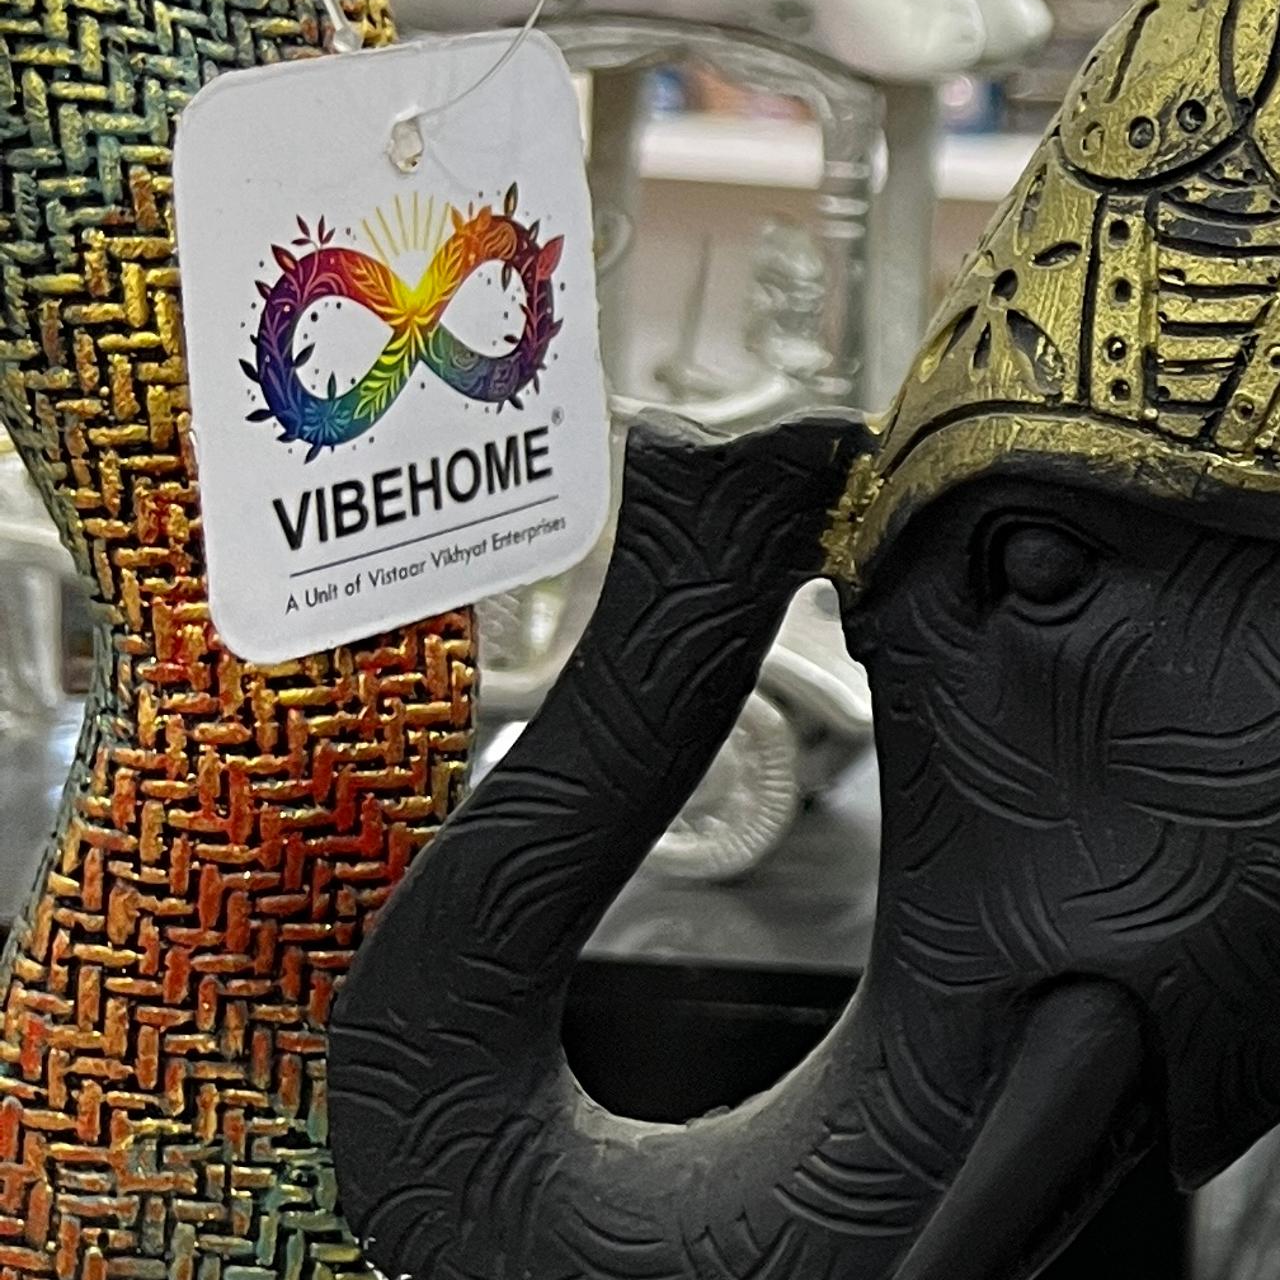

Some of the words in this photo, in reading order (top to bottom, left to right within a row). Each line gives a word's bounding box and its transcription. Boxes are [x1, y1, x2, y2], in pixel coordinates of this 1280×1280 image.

[271, 424, 554, 552] VIBEHOME
[284, 593, 299, 615] A
[305, 583, 338, 608] Unit
[344, 576, 362, 597] of
[367, 559, 426, 588] Vistaar
[430, 538, 488, 569] Vikhyat
[491, 516, 567, 552] Enterprises
